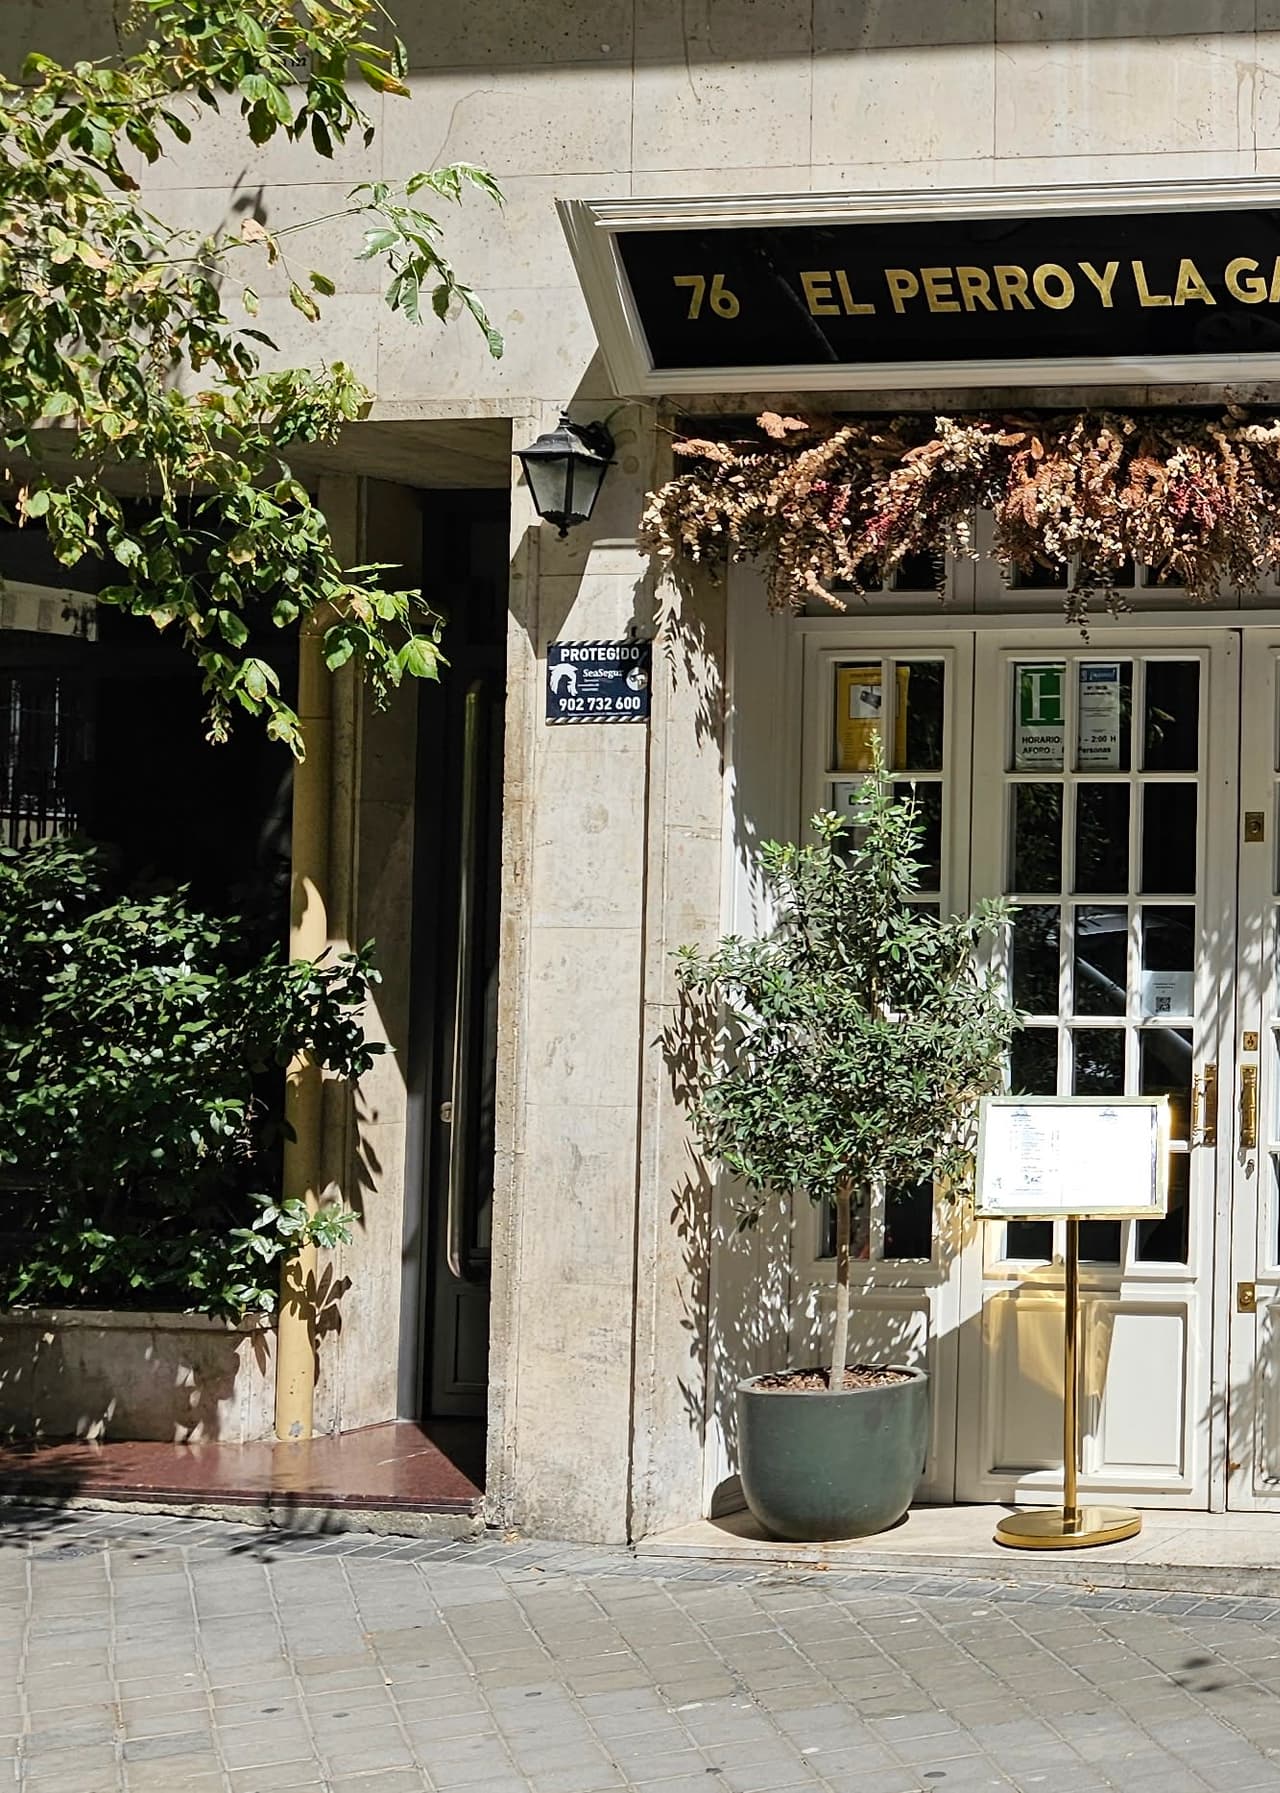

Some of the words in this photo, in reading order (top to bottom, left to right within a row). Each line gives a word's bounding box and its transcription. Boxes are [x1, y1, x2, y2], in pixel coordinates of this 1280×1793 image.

[674, 274, 740, 319] 76
[801, 270, 875, 315] EL
[885, 263, 1075, 313] PERRO
[1079, 261, 1119, 308] Y
[1132, 258, 1216, 307] LA
[560, 647, 640, 662] PROTEGIDO
[559, 698, 584, 711] 902
[587, 698, 612, 710] 732
[615, 697, 641, 710] 600
